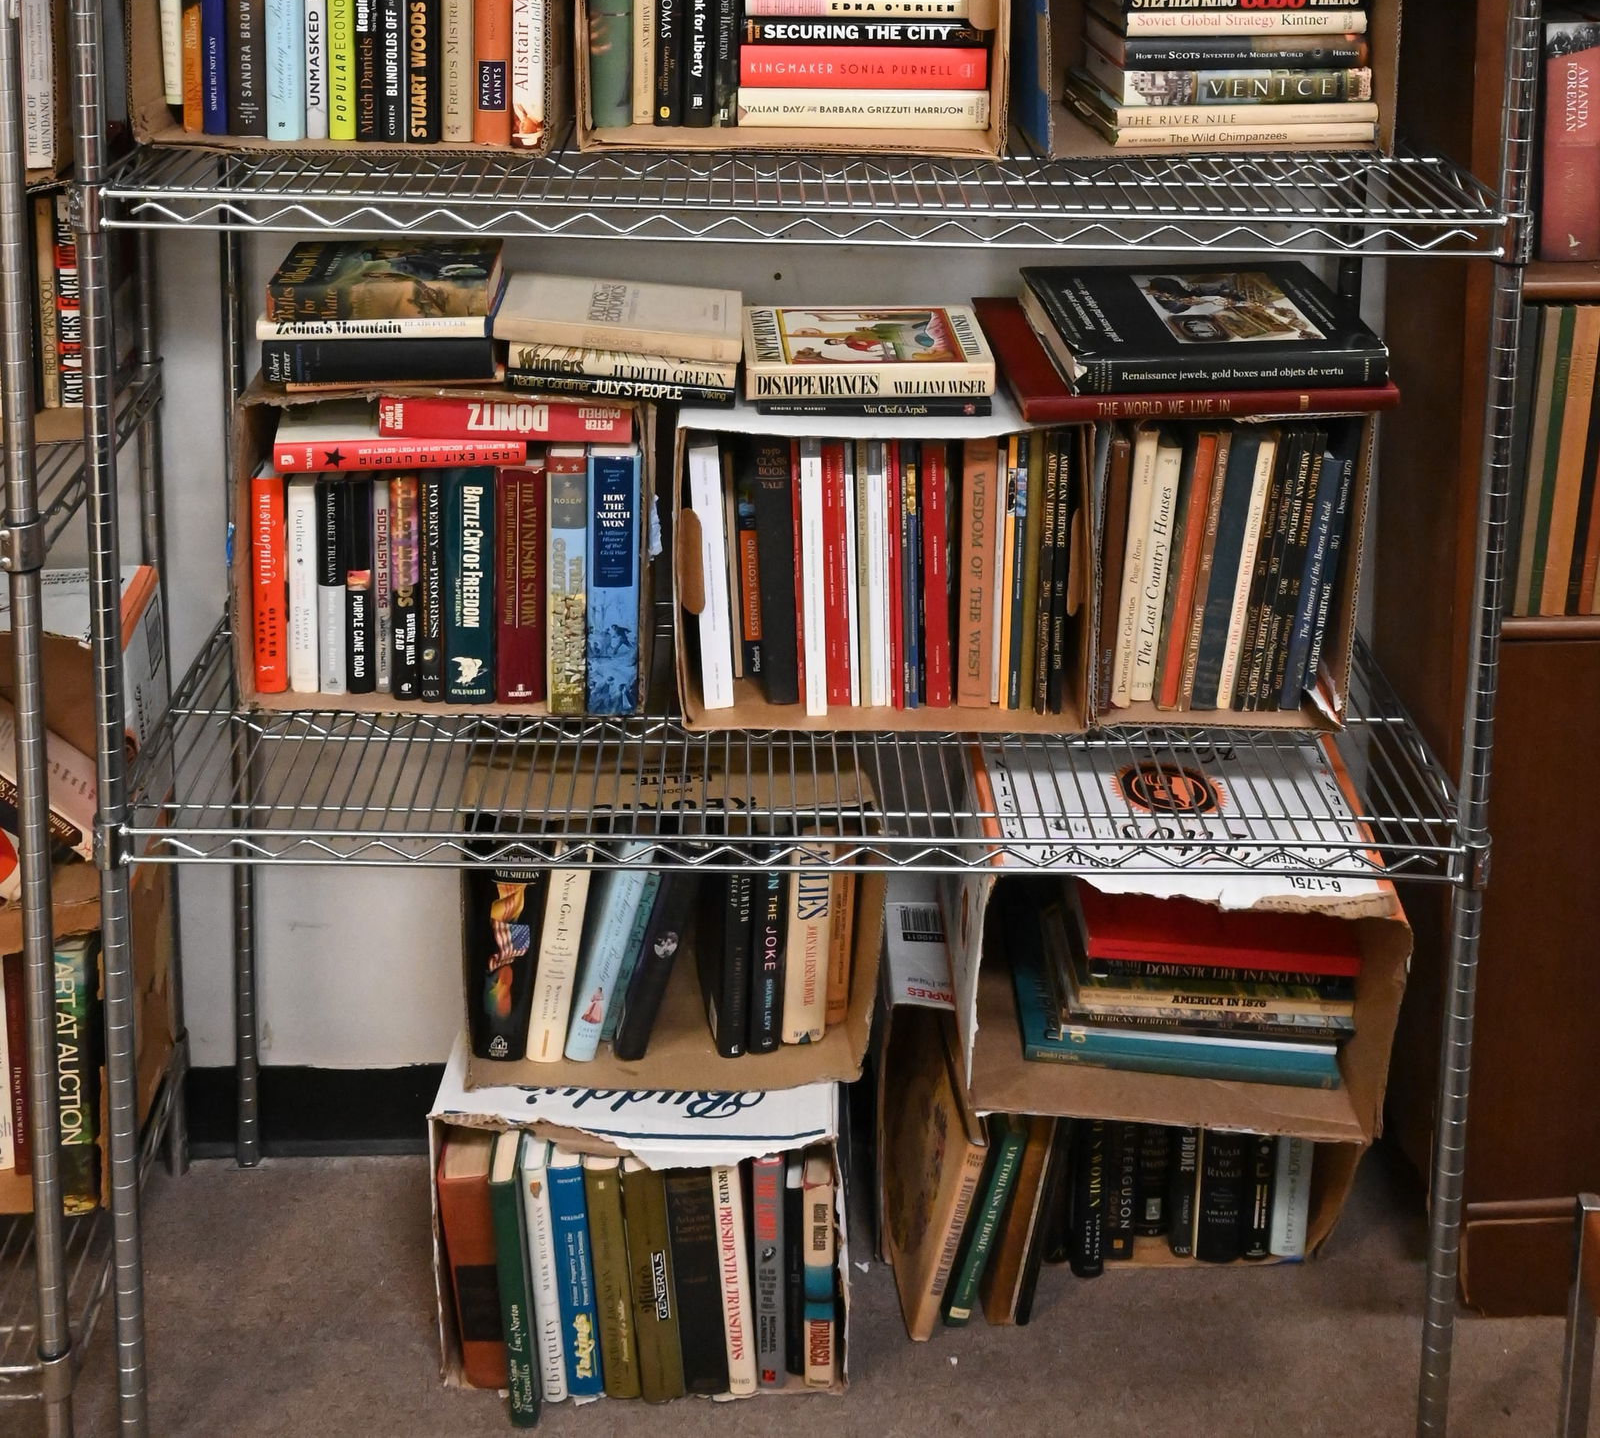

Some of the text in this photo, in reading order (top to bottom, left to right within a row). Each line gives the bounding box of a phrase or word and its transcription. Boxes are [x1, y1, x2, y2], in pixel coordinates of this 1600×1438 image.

[386, 9, 398, 30] OFF
[411, 2, 426, 67] WOODS
[695, 14, 705, 32] for
[764, 25, 951, 41] SECURING THE CITY
[1137, 13, 1328, 27] Soviet Global Strategy Kintner
[242, 38, 252, 98] SANDRA
[310, 10, 320, 106] UNMASKED
[386, 32, 398, 97] BLINDFOLDS
[691, 34, 704, 78] Liberty
[750, 63, 952, 75] KINGMAKER SONIA PURNELL
[1168, 51, 1200, 59] SCOTS
[1332, 49, 1359, 57] HERMAN
[412, 70, 428, 138] STUART
[1210, 79, 1331, 96] VENICE
[1566, 62, 1577, 132] FOREMAN
[1578, 67, 1589, 129] AMANDA
[757, 375, 986, 395] DISAPPEARANCES WILLIAM WISER
[1122, 368, 1344, 381] Renaissance jewels, gold boxes and objets de vertu
[597, 511, 630, 519] NORTH
[602, 494, 625, 502] HOW
[463, 486, 483, 628] BATTLE CRY OF FREEDOM
[968, 472, 985, 680] WISDOM OF THE WEST
[1137, 486, 1172, 667] The Last Country Houses
[353, 595, 364, 678] PURPLE CANE ROAD
[768, 896, 777, 920] THE
[764, 927, 777, 971] JOKE
[1171, 995, 1266, 1007] AMERICA IN 1876
[55, 962, 83, 1147] ART AT AUCTION
[657, 1252, 669, 1319] GENERALS
[719, 1207, 744, 1361] PRESIDENTIAL TRANSITIONS
